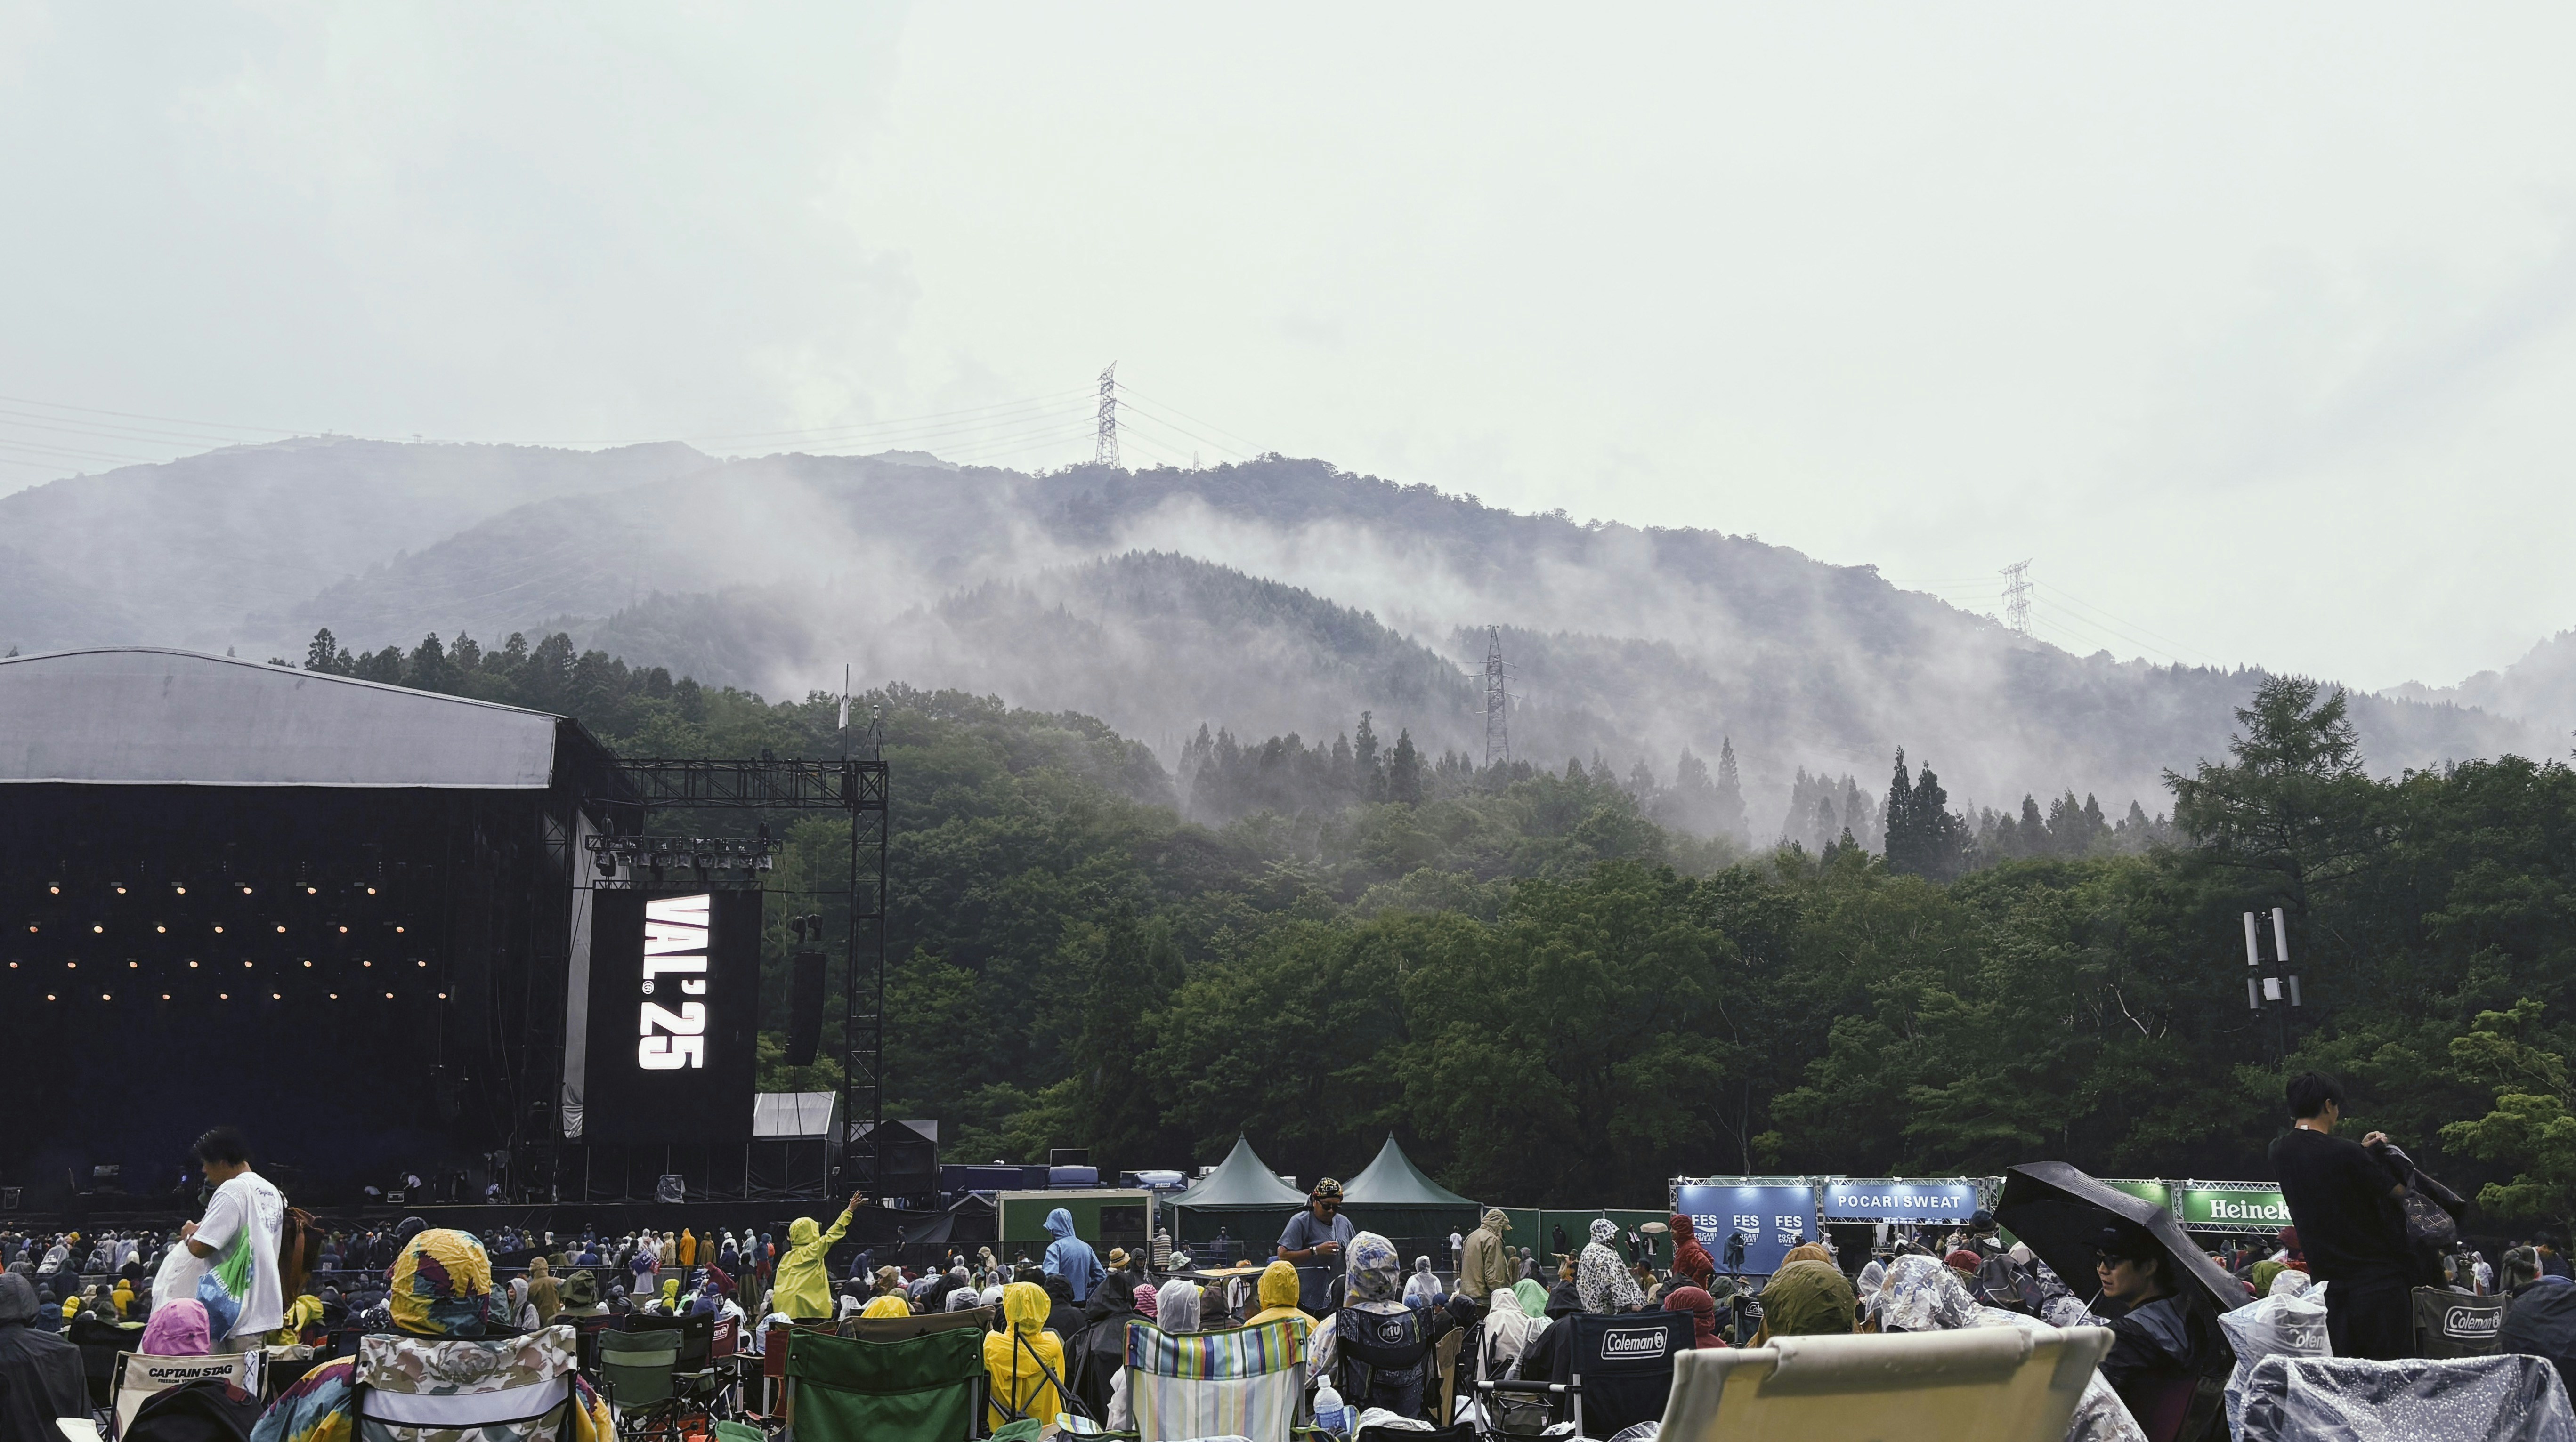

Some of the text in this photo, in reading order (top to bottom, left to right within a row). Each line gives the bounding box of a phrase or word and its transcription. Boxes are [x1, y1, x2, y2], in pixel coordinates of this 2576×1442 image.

[1838, 1196, 1960, 1208] POCARI SWEAT
[2209, 1200, 2292, 1220] Heinek
[1692, 1215, 1717, 1226] FES
[1733, 1215, 1759, 1226] FES
[1775, 1216, 1803, 1227] FES
[2450, 1310, 2492, 1329] Coleman
[1607, 1333, 1653, 1351] Coleman
[149, 1364, 233, 1378] CAPTAIN STAG
